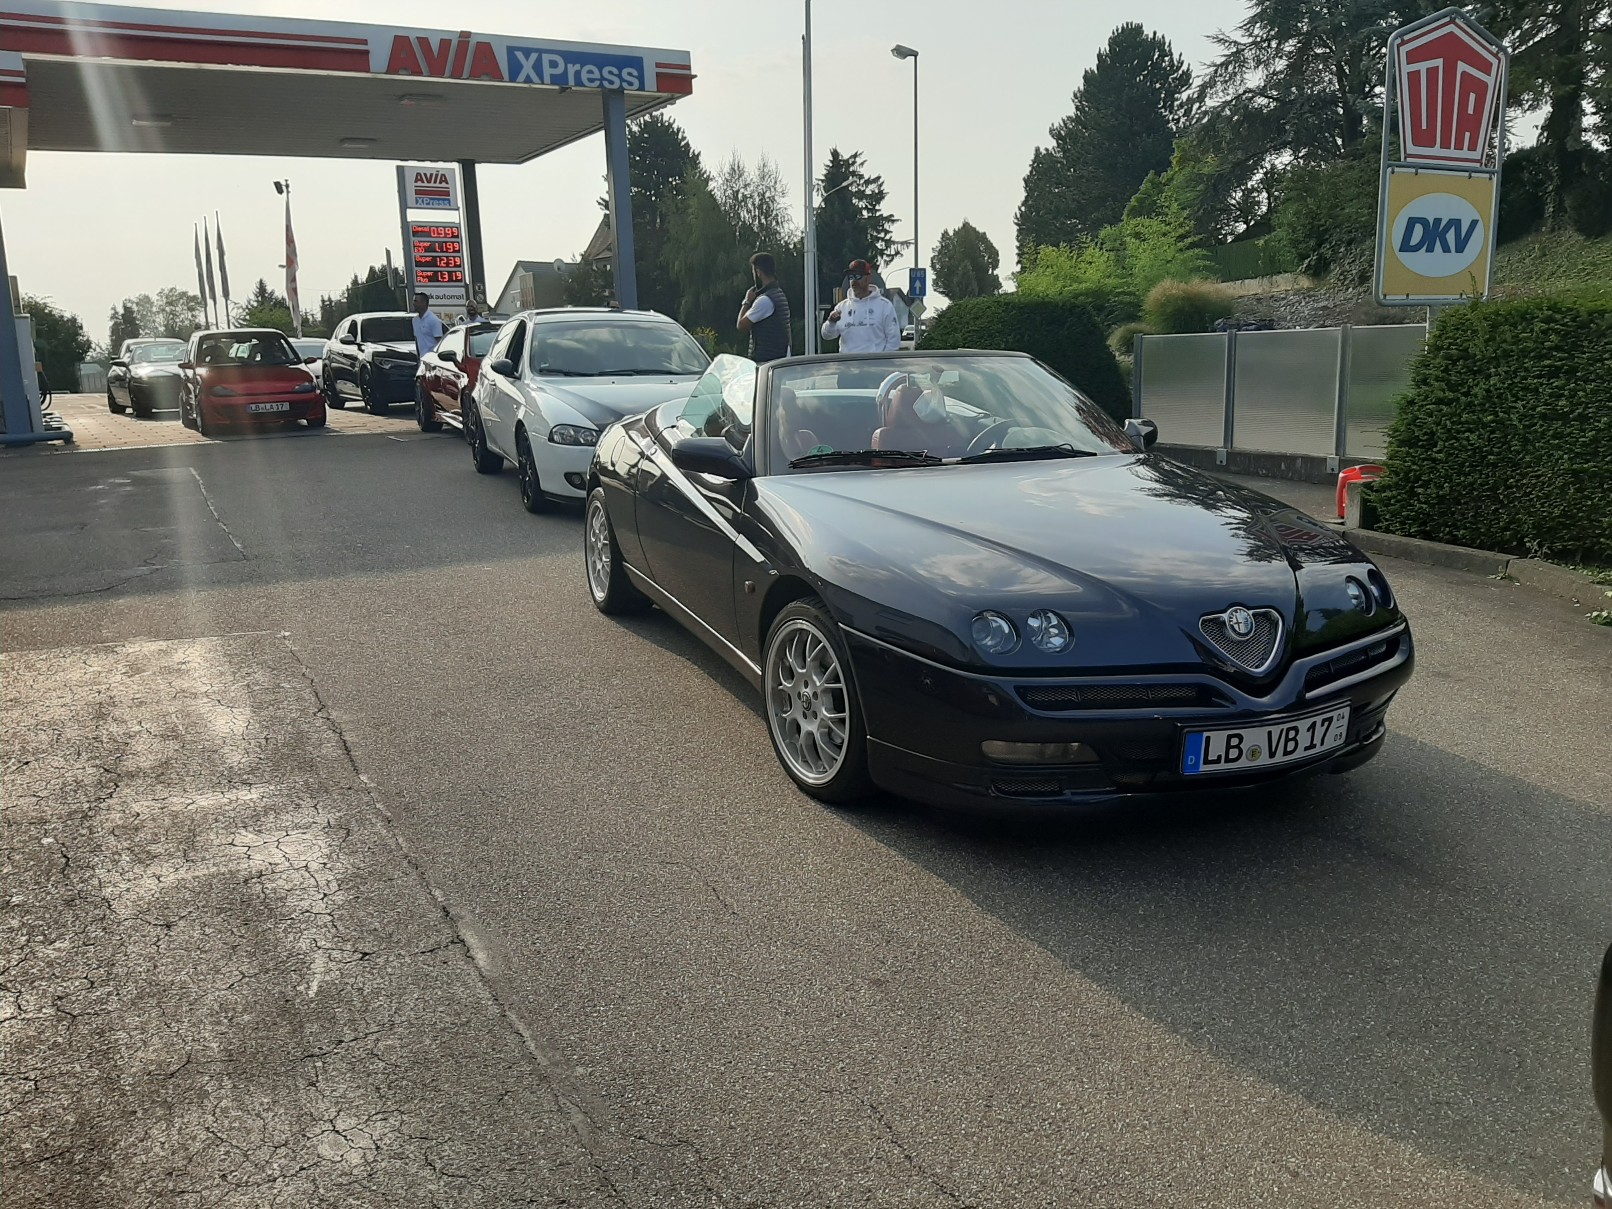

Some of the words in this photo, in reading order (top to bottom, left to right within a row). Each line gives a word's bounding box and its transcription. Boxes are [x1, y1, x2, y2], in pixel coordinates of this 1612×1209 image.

[513, 50, 640, 91] XPress
[1406, 31, 1494, 151] UTA
[416, 197, 449, 207] XPress
[1399, 216, 1480, 254] DKV
[1187, 755, 1195, 765] D
[1202, 733, 1244, 765] LB
[1265, 725, 1299, 759] VB
[1303, 716, 1334, 752] 17
